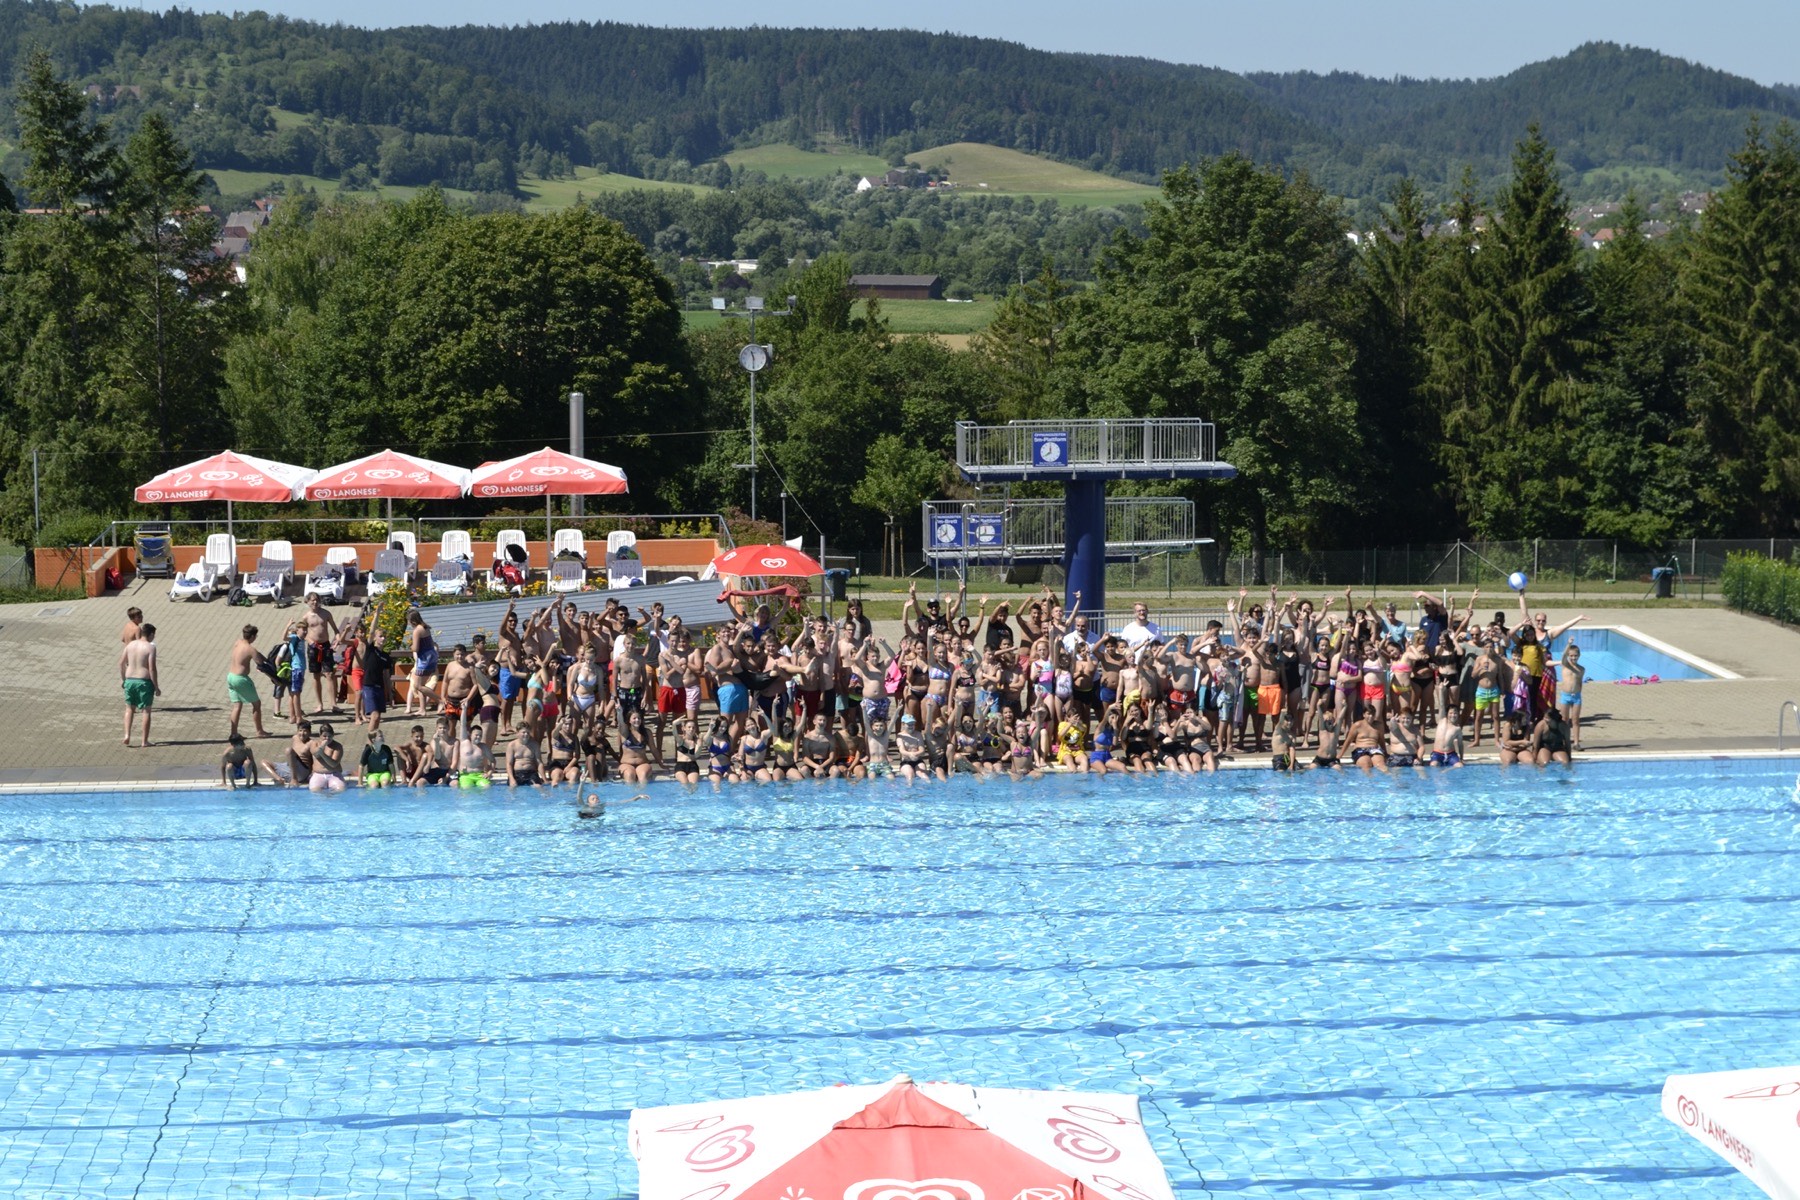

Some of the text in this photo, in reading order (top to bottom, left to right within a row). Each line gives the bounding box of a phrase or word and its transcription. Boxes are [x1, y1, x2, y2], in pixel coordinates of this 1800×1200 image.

[333, 488, 377, 497] LANGNESE
[500, 484, 544, 494] LANGNESE
[164, 490, 208, 499] LANGNESE
[1701, 1112, 1754, 1168] LANGNESE
